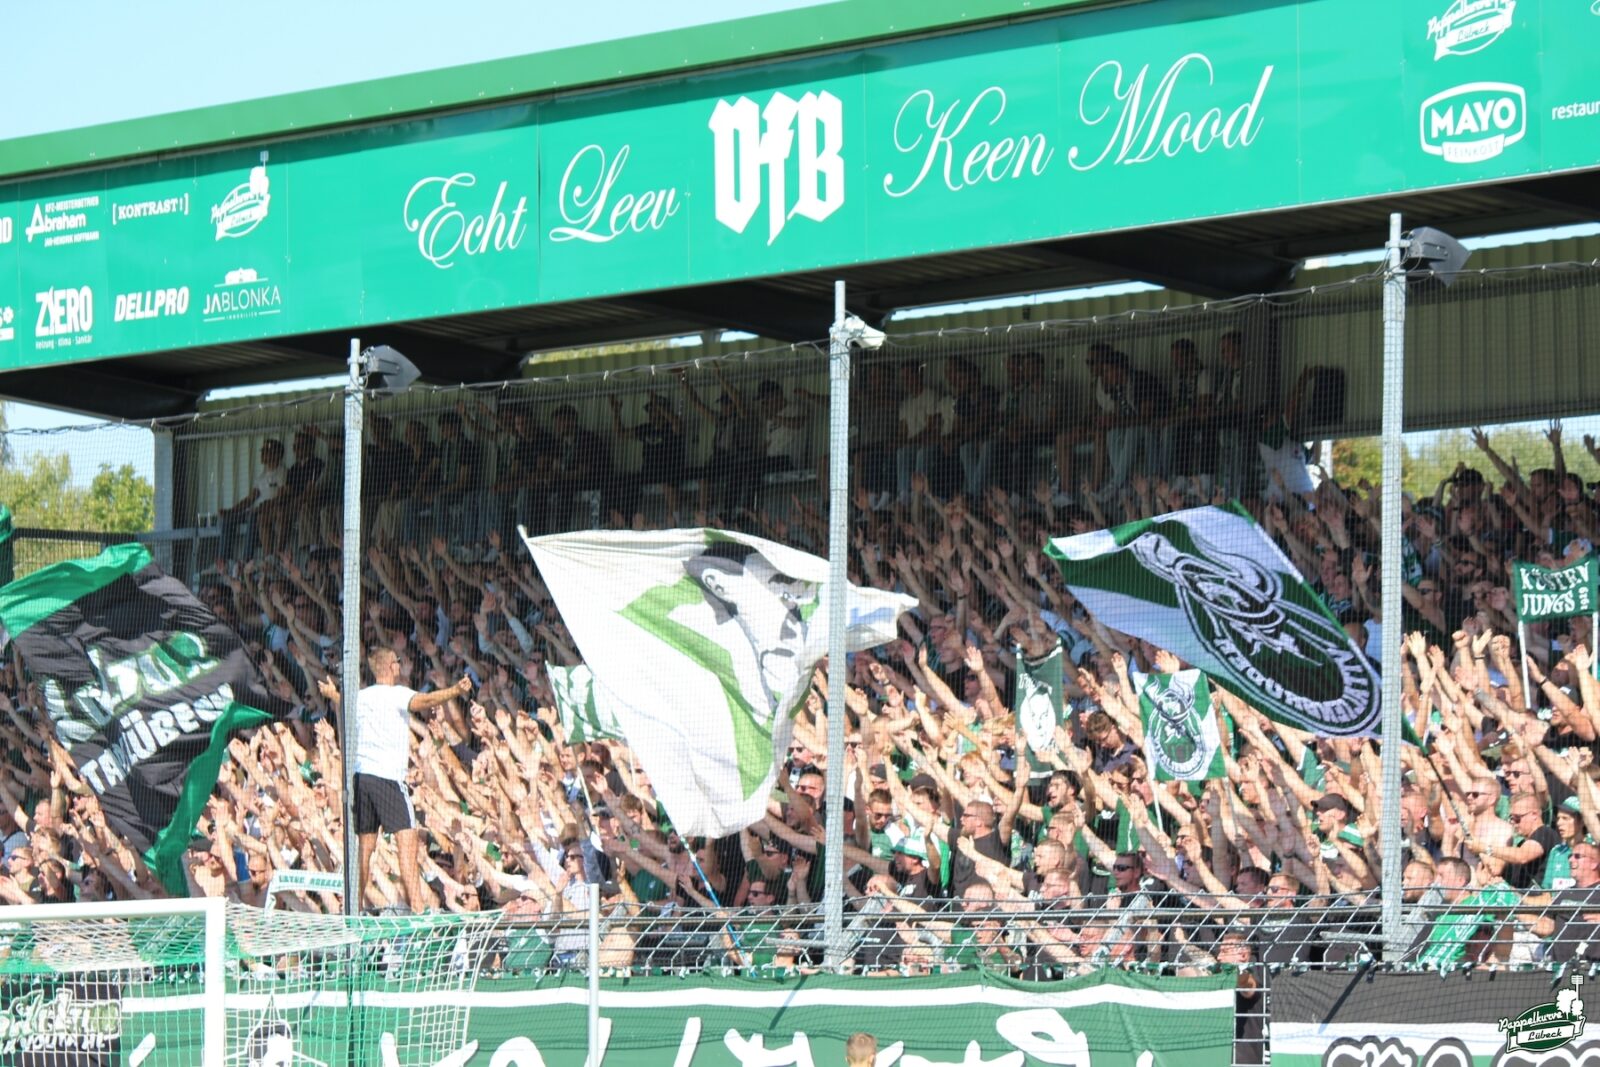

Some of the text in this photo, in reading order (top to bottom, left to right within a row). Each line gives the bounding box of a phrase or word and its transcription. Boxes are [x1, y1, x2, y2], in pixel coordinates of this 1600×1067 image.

[1431, 97, 1517, 139] MAYO
[402, 172, 528, 269] Echt
[549, 144, 680, 243] Leev
[883, 86, 1054, 198] Keen
[1068, 53, 1274, 171] Mood
[25, 203, 87, 243] Abraham
[114, 286, 189, 322] DELLPRO
[203, 285, 281, 315] JABLONKA
[1521, 589, 1576, 616] JUNGS
